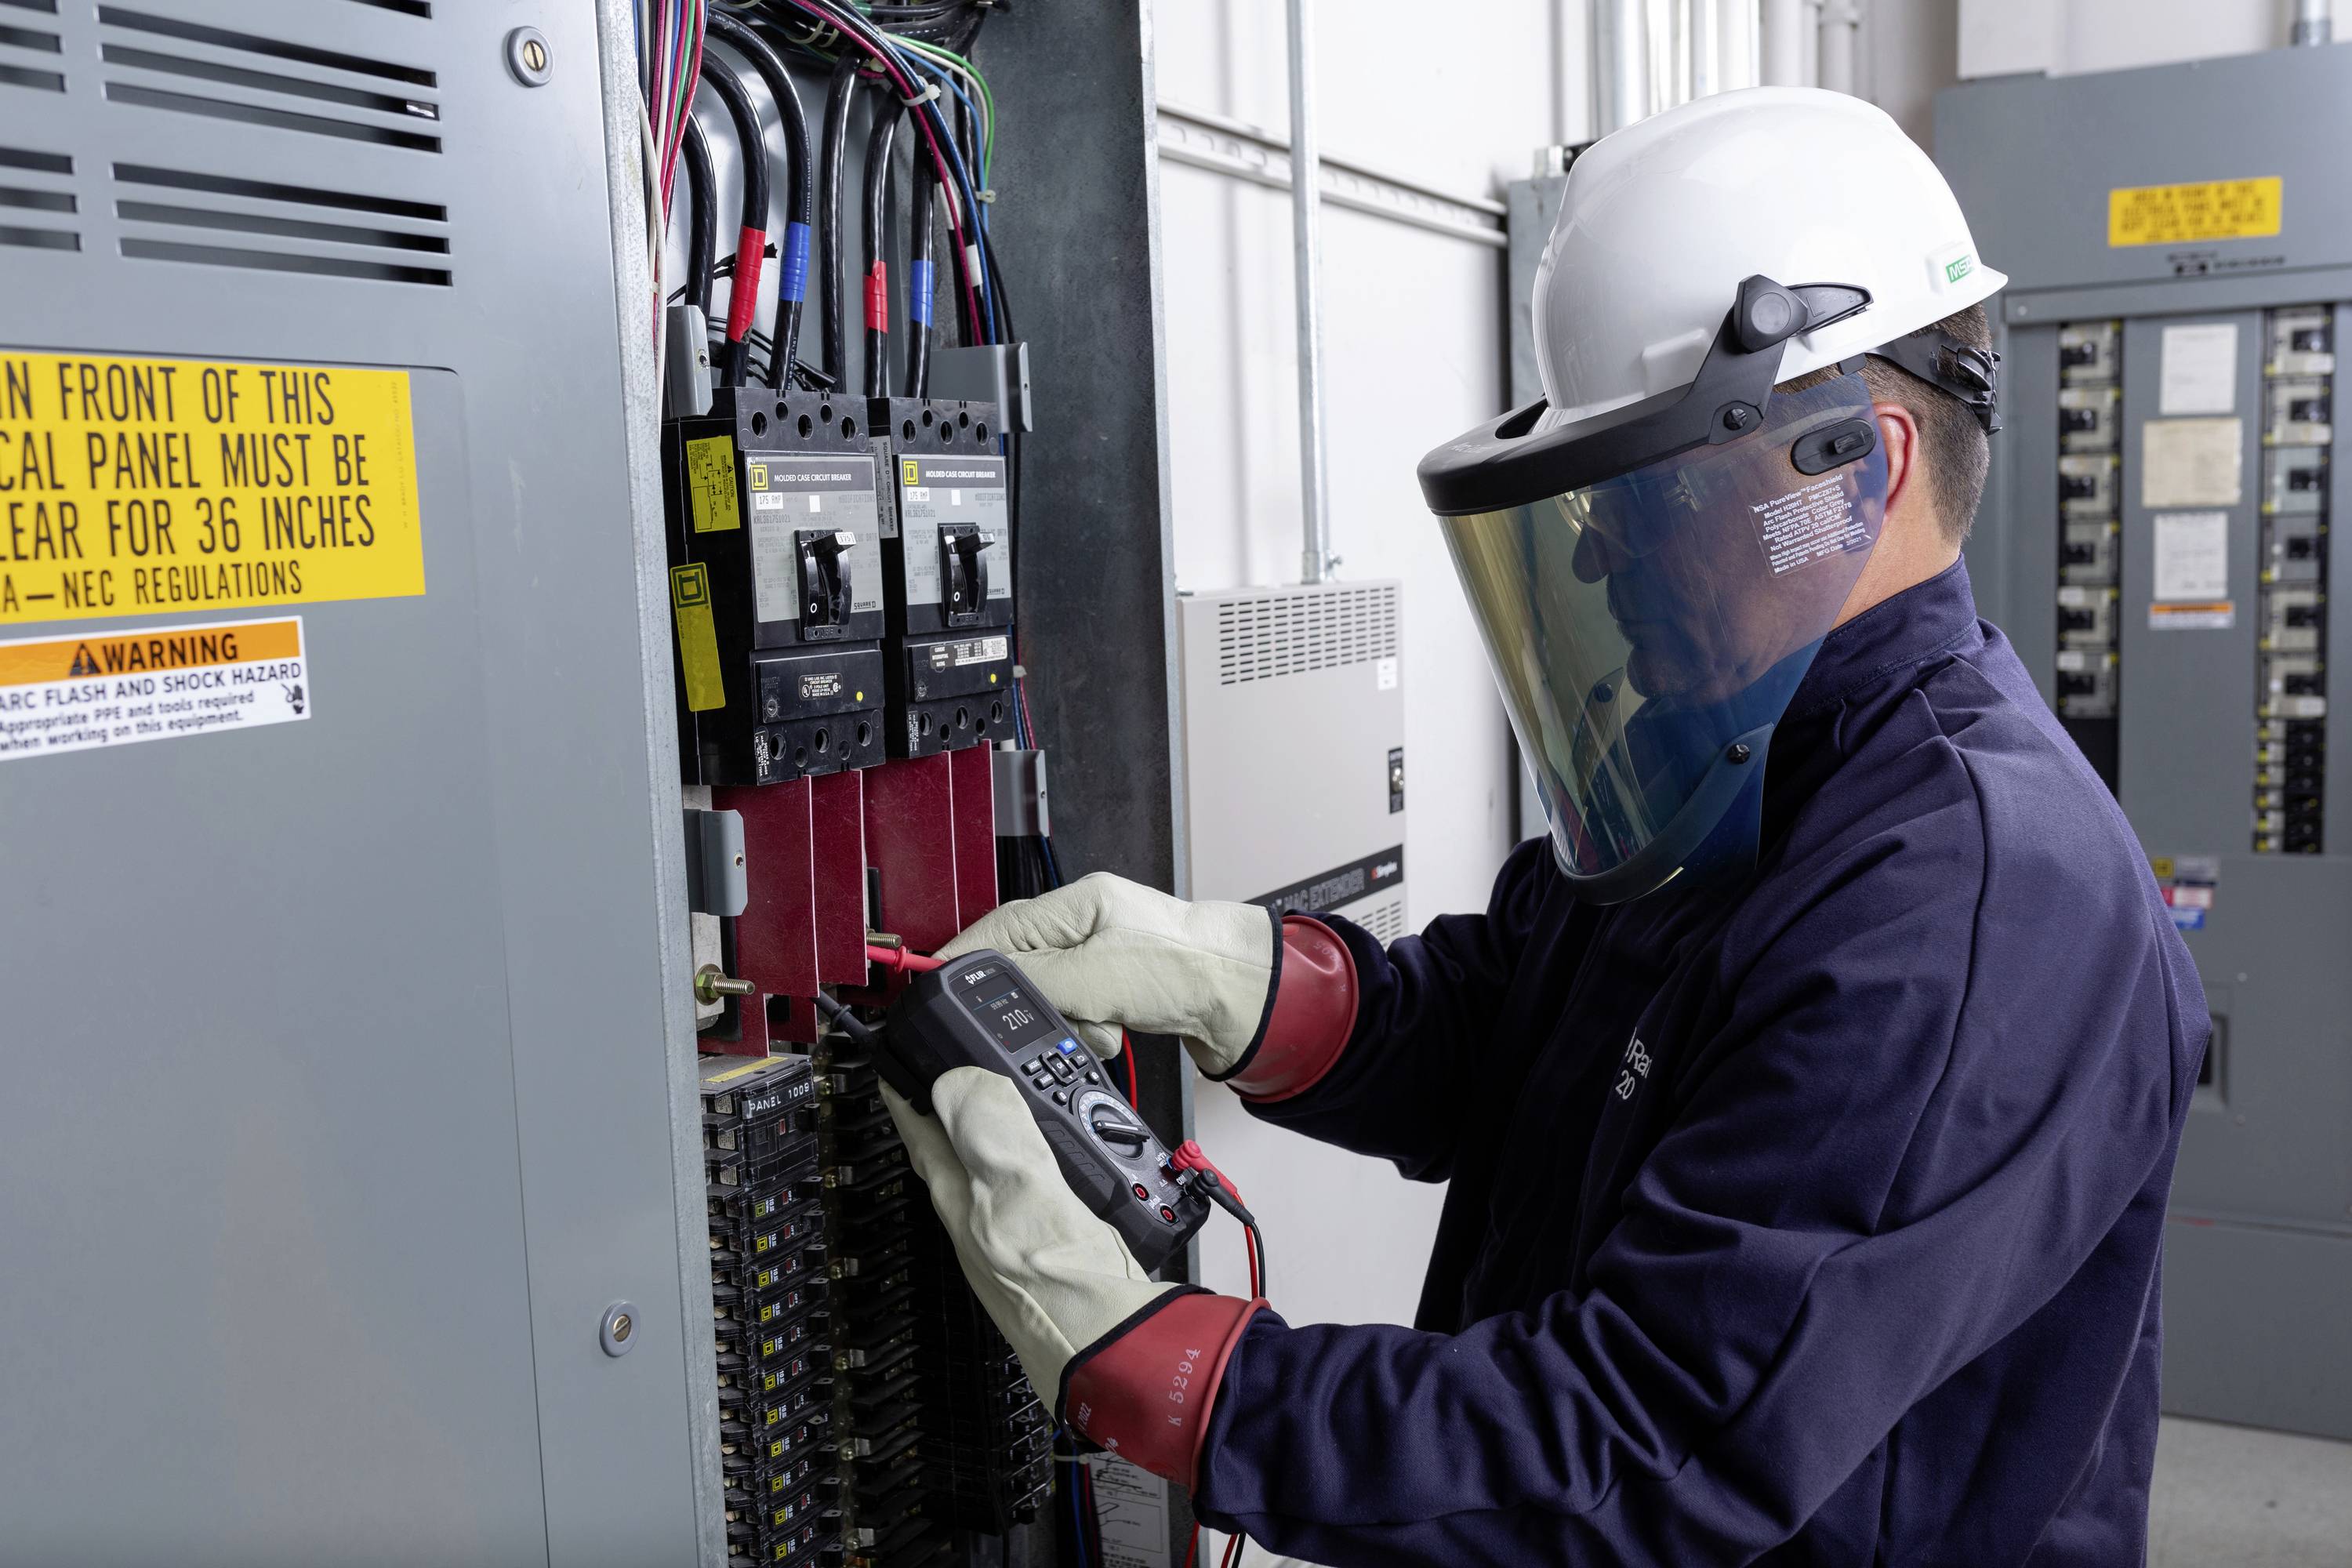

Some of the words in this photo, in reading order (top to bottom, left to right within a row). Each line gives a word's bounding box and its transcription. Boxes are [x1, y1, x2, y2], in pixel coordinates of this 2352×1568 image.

[0, 361, 33, 420] N
[59, 362, 176, 422] FRONT
[202, 368, 240, 423] OF
[260, 370, 335, 426] THIS
[87, 431, 201, 490] PANEL
[220, 433, 312, 488] MUST
[332, 434, 370, 487] BE
[774, 474, 797, 482] MOLDED
[797, 474, 811, 482] CASE
[831, 473, 852, 481] BREAKER
[759, 495, 769, 505] 175
[771, 495, 782, 504] AMP
[1753, 503, 1769, 514] NSA
[1806, 473, 1843, 493] Faceshield
[1774, 511, 1792, 522] Flash
[1792, 499, 1824, 515] Protective
[1824, 490, 1845, 503] Shield
[0, 500, 84, 561] EAR
[107, 499, 176, 557] FOR
[195, 496, 241, 554] 36
[261, 494, 376, 550] INCHES
[1762, 531, 1782, 541] Meets
[1782, 522, 1800, 533] NFPA
[1799, 517, 1813, 526] 70E
[1814, 510, 1833, 521] ASTM
[1763, 507, 1784, 519] Model
[1765, 513, 1809, 532] Polycarbonate
[1811, 504, 1828, 514] Color
[1829, 498, 1845, 508] Grey
[1769, 543, 1783, 552] Not
[1781, 531, 1814, 548] Warranted
[1813, 515, 1853, 535] Shatterproof
[1774, 532, 1793, 543] Rated
[1794, 524, 1810, 536] ATPV
[1773, 564, 1790, 574] Made
[1795, 556, 1809, 565] USA
[1816, 547, 1831, 557] MFG
[1830, 543, 1844, 553] Date
[134, 560, 303, 604] REGULATIONS
[102, 633, 238, 673] WARNING
[45, 684, 107, 706] FLASH
[116, 677, 155, 699] AND
[163, 670, 226, 693] SHOCK
[232, 662, 302, 685] HAZARD
[94, 706, 123, 720] PPE
[128, 702, 153, 717] and
[159, 698, 193, 714] tools
[198, 689, 255, 710] required
[48, 728, 108, 746] working
[113, 725, 131, 737] on
[136, 719, 162, 734] this
[971, 970, 987, 982] FLIR
[1002, 1009, 1029, 1030] 210
[749, 1094, 782, 1112] PANEL
[1169, 1348, 1201, 1404] 5294
